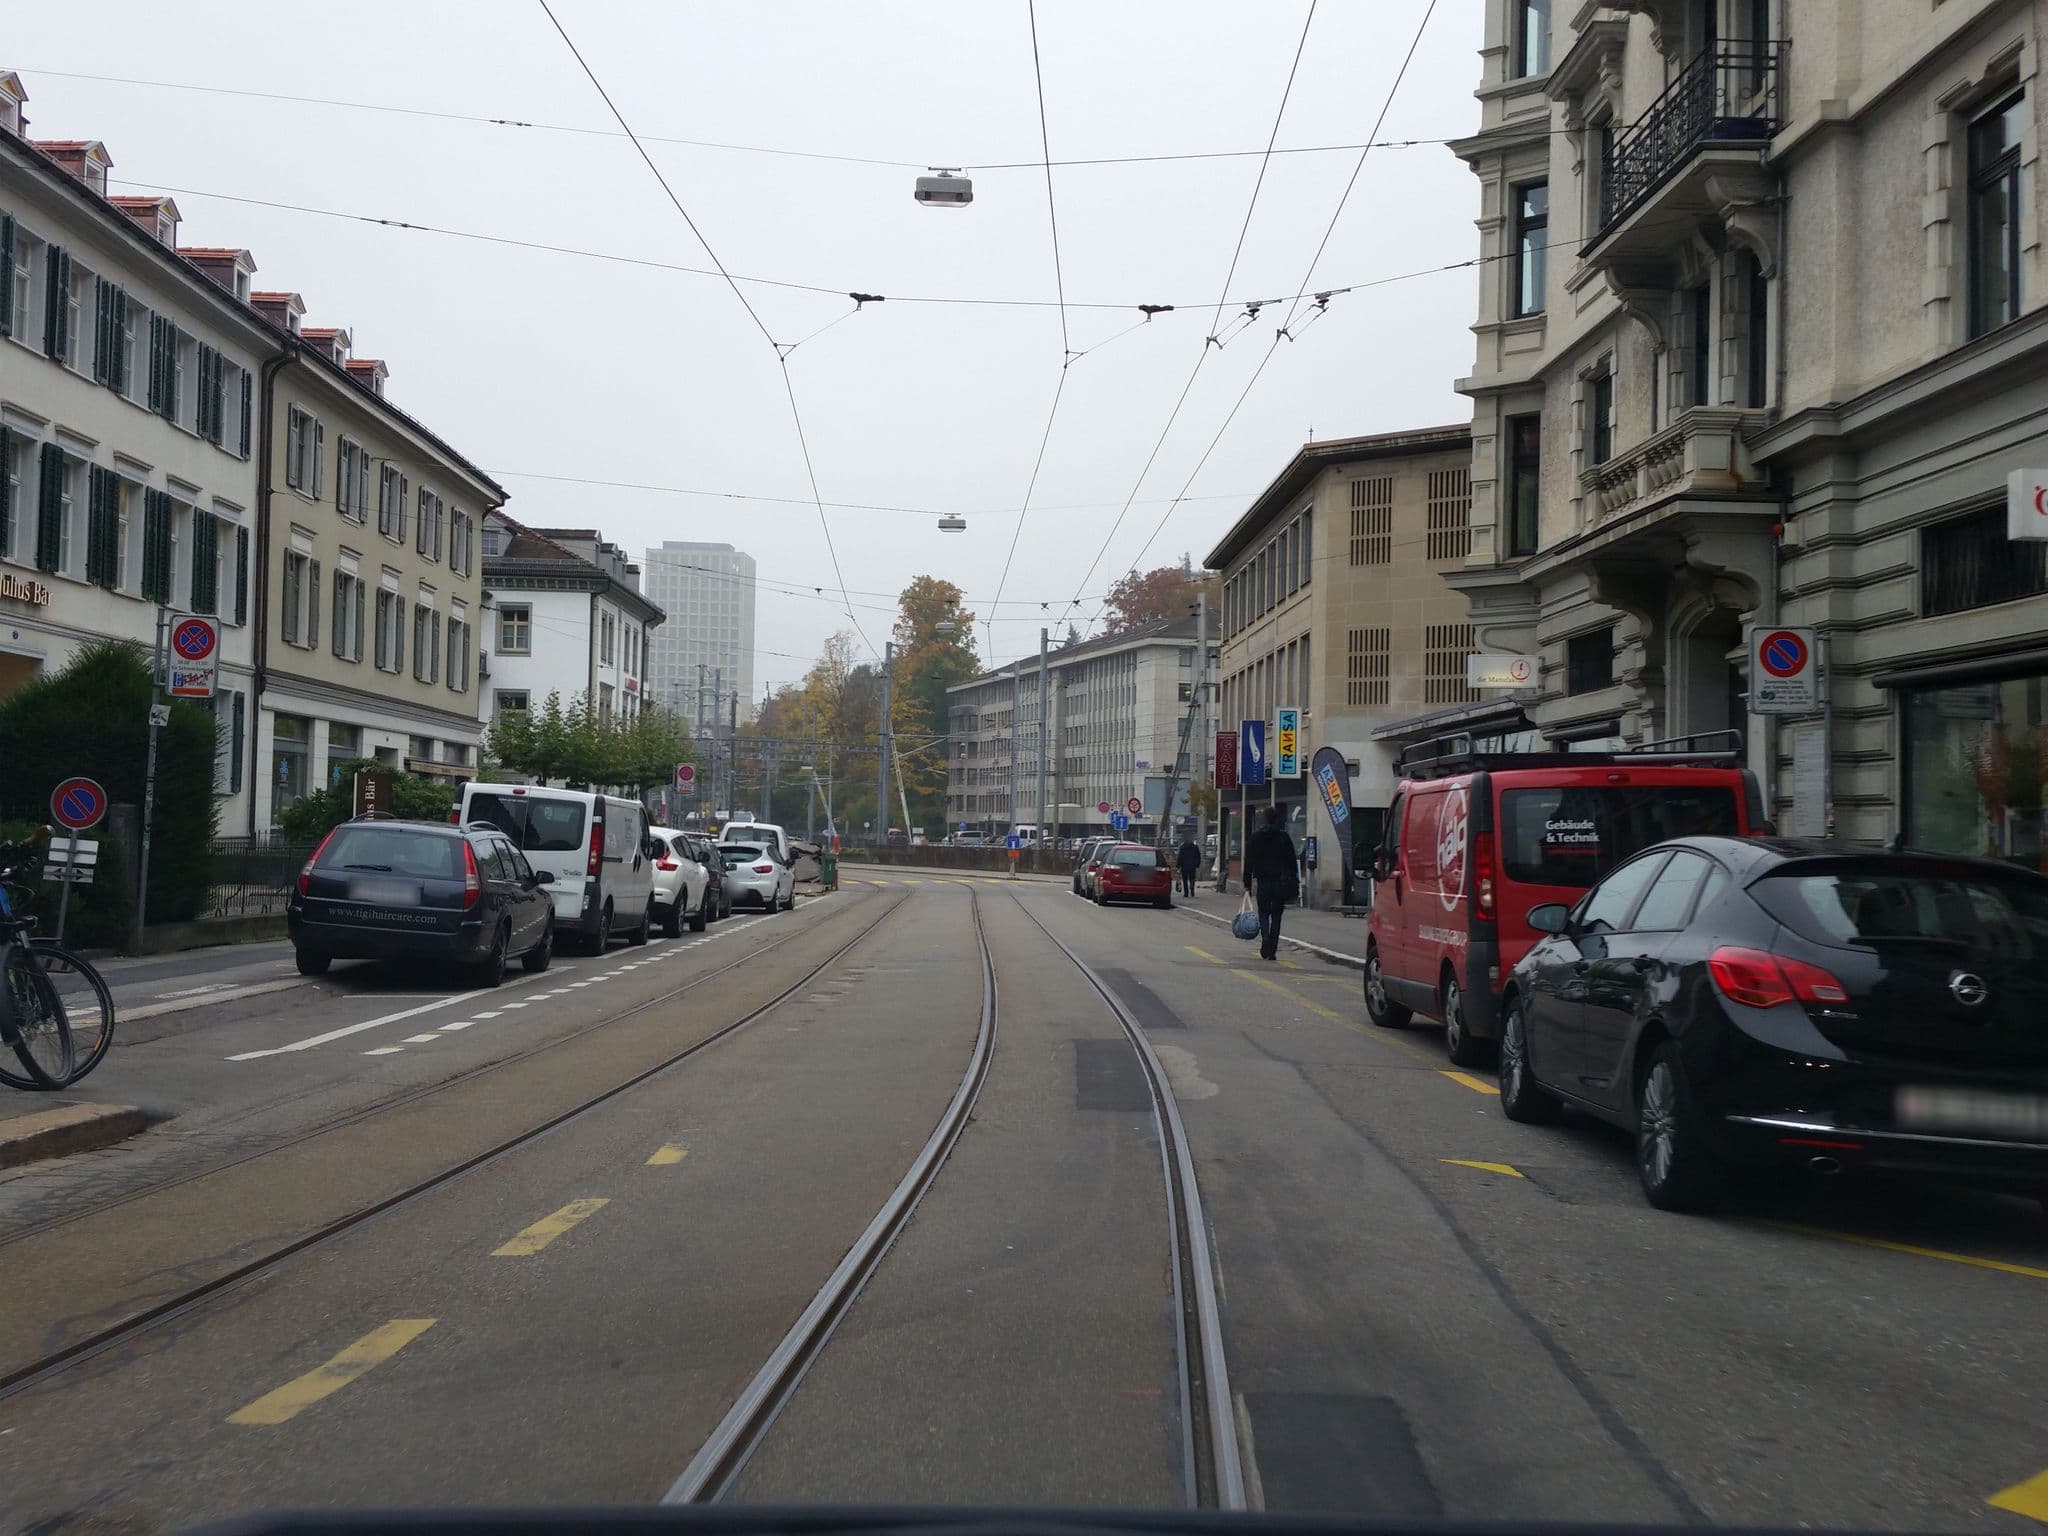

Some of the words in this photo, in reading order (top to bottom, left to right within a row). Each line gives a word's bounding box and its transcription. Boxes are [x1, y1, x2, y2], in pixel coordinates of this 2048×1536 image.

[33, 582, 54, 606] Bär
[1282, 713, 1294, 771] TRANSA
[365, 778, 376, 800] Bär
[1546, 820, 1596, 830] Gebäude
[1546, 832, 1556, 843] &
[1556, 832, 1600, 843] Technik
